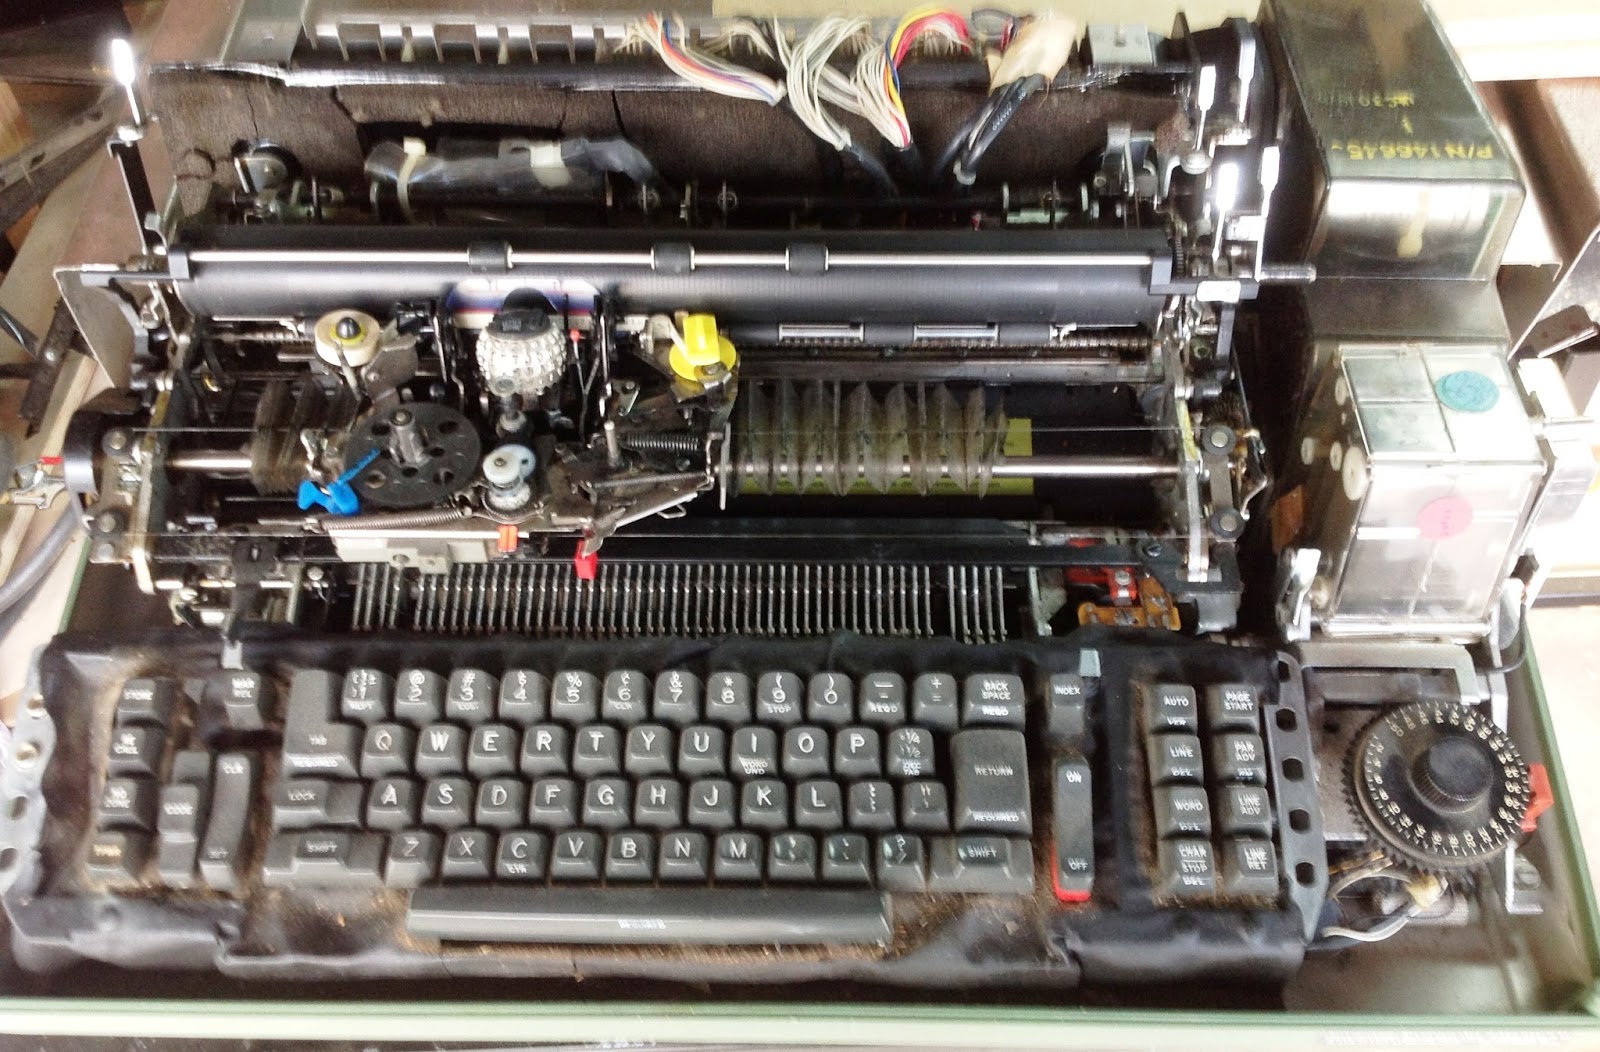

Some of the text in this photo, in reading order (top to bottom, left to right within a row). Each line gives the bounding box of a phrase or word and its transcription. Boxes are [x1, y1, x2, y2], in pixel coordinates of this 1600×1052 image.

[409, 670, 425, 686] @
[462, 670, 476, 686] #
[565, 672, 582, 688] %
[670, 671, 683, 688] &
[983, 679, 1008, 692] BACK
[408, 685, 422, 701] 2
[460, 685, 474, 701] 3
[513, 686, 527, 702] 4
[566, 687, 580, 702] 5
[618, 686, 631, 700] 6
[669, 687, 683, 702] 7
[721, 687, 735, 703] 8
[772, 687, 786, 703] 9
[981, 690, 1011, 701] SPACE
[1053, 684, 1081, 695] INDEX
[1225, 690, 1251, 702] PAGE
[766, 704, 791, 714] STOP
[1164, 695, 1189, 707] AUTO
[1224, 701, 1254, 711] START
[375, 730, 392, 751] Q
[430, 730, 449, 751] W
[483, 730, 499, 751] E
[536, 730, 552, 751] R
[588, 730, 604, 751] T
[641, 730, 656, 751] Y
[693, 731, 710, 752] U
[797, 731, 814, 753] O
[850, 732, 865, 754] P
[1170, 745, 1194, 757] LINE
[1235, 751, 1255, 761] ADV
[974, 764, 1013, 776] RETURN
[1066, 770, 1082, 783] ON
[287, 789, 316, 801] LOCK
[381, 783, 397, 805] A
[437, 783, 453, 805] S
[491, 784, 507, 806] D
[545, 784, 561, 805] F
[598, 784, 615, 806] G
[651, 784, 667, 806] H
[703, 784, 719, 806] J
[756, 785, 772, 806] K
[811, 785, 826, 807] L
[1238, 793, 1261, 806] LINE
[1173, 798, 1203, 811] WORD
[1240, 805, 1261, 815] ADV
[972, 811, 1019, 822] REQUIRED
[306, 841, 338, 853] SHIFT
[403, 836, 419, 857] Z
[460, 836, 475, 856] X
[510, 837, 528, 859] C
[568, 836, 584, 857] V
[621, 837, 637, 858] B
[674, 836, 691, 858] N
[729, 836, 747, 858] M
[966, 844, 997, 858] SHIFT
[1178, 844, 1207, 857] CHAR
[1243, 847, 1267, 860] LINE
[1067, 857, 1088, 870] OFF
[1181, 862, 1208, 873] STOP
[1247, 860, 1267, 870] RET
